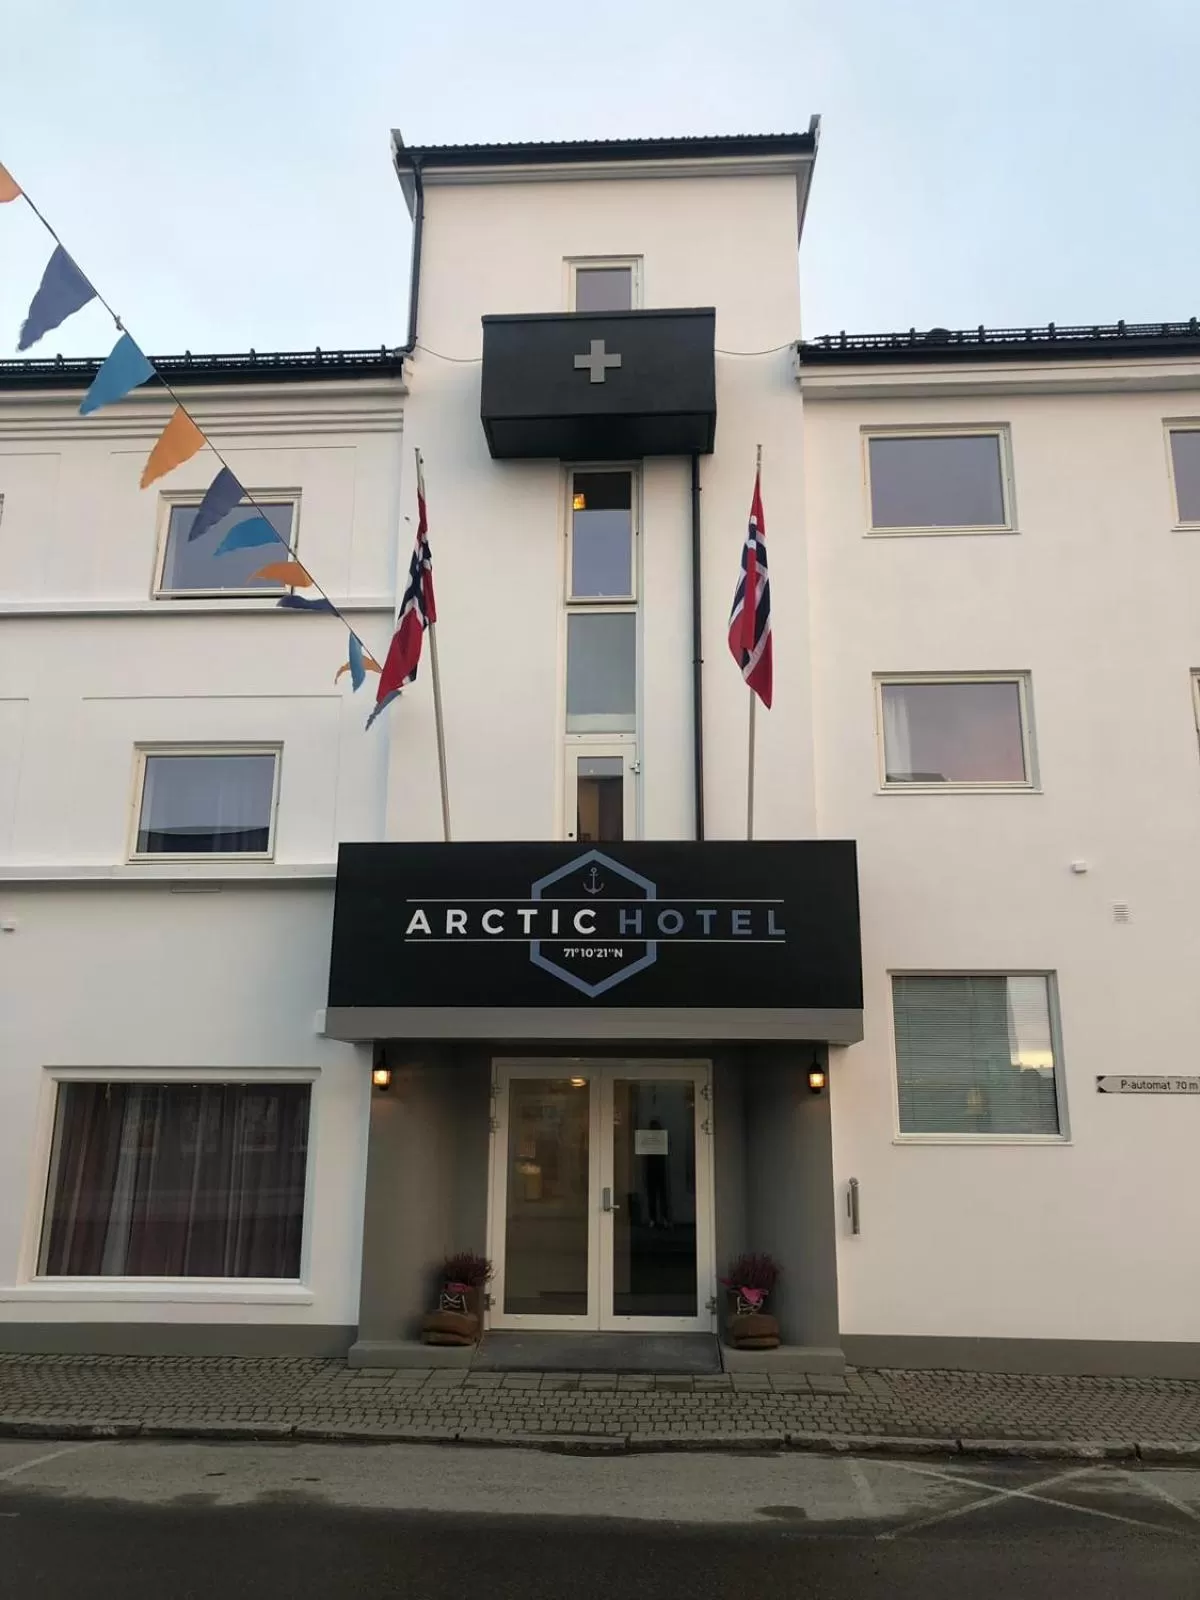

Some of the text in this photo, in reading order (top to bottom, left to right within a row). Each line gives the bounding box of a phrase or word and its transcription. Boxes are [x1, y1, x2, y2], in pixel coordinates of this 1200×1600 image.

[405, 908, 786, 936] ARCTIC HOTEL
[1120, 1079, 1199, 1090] P-automat 70 m
